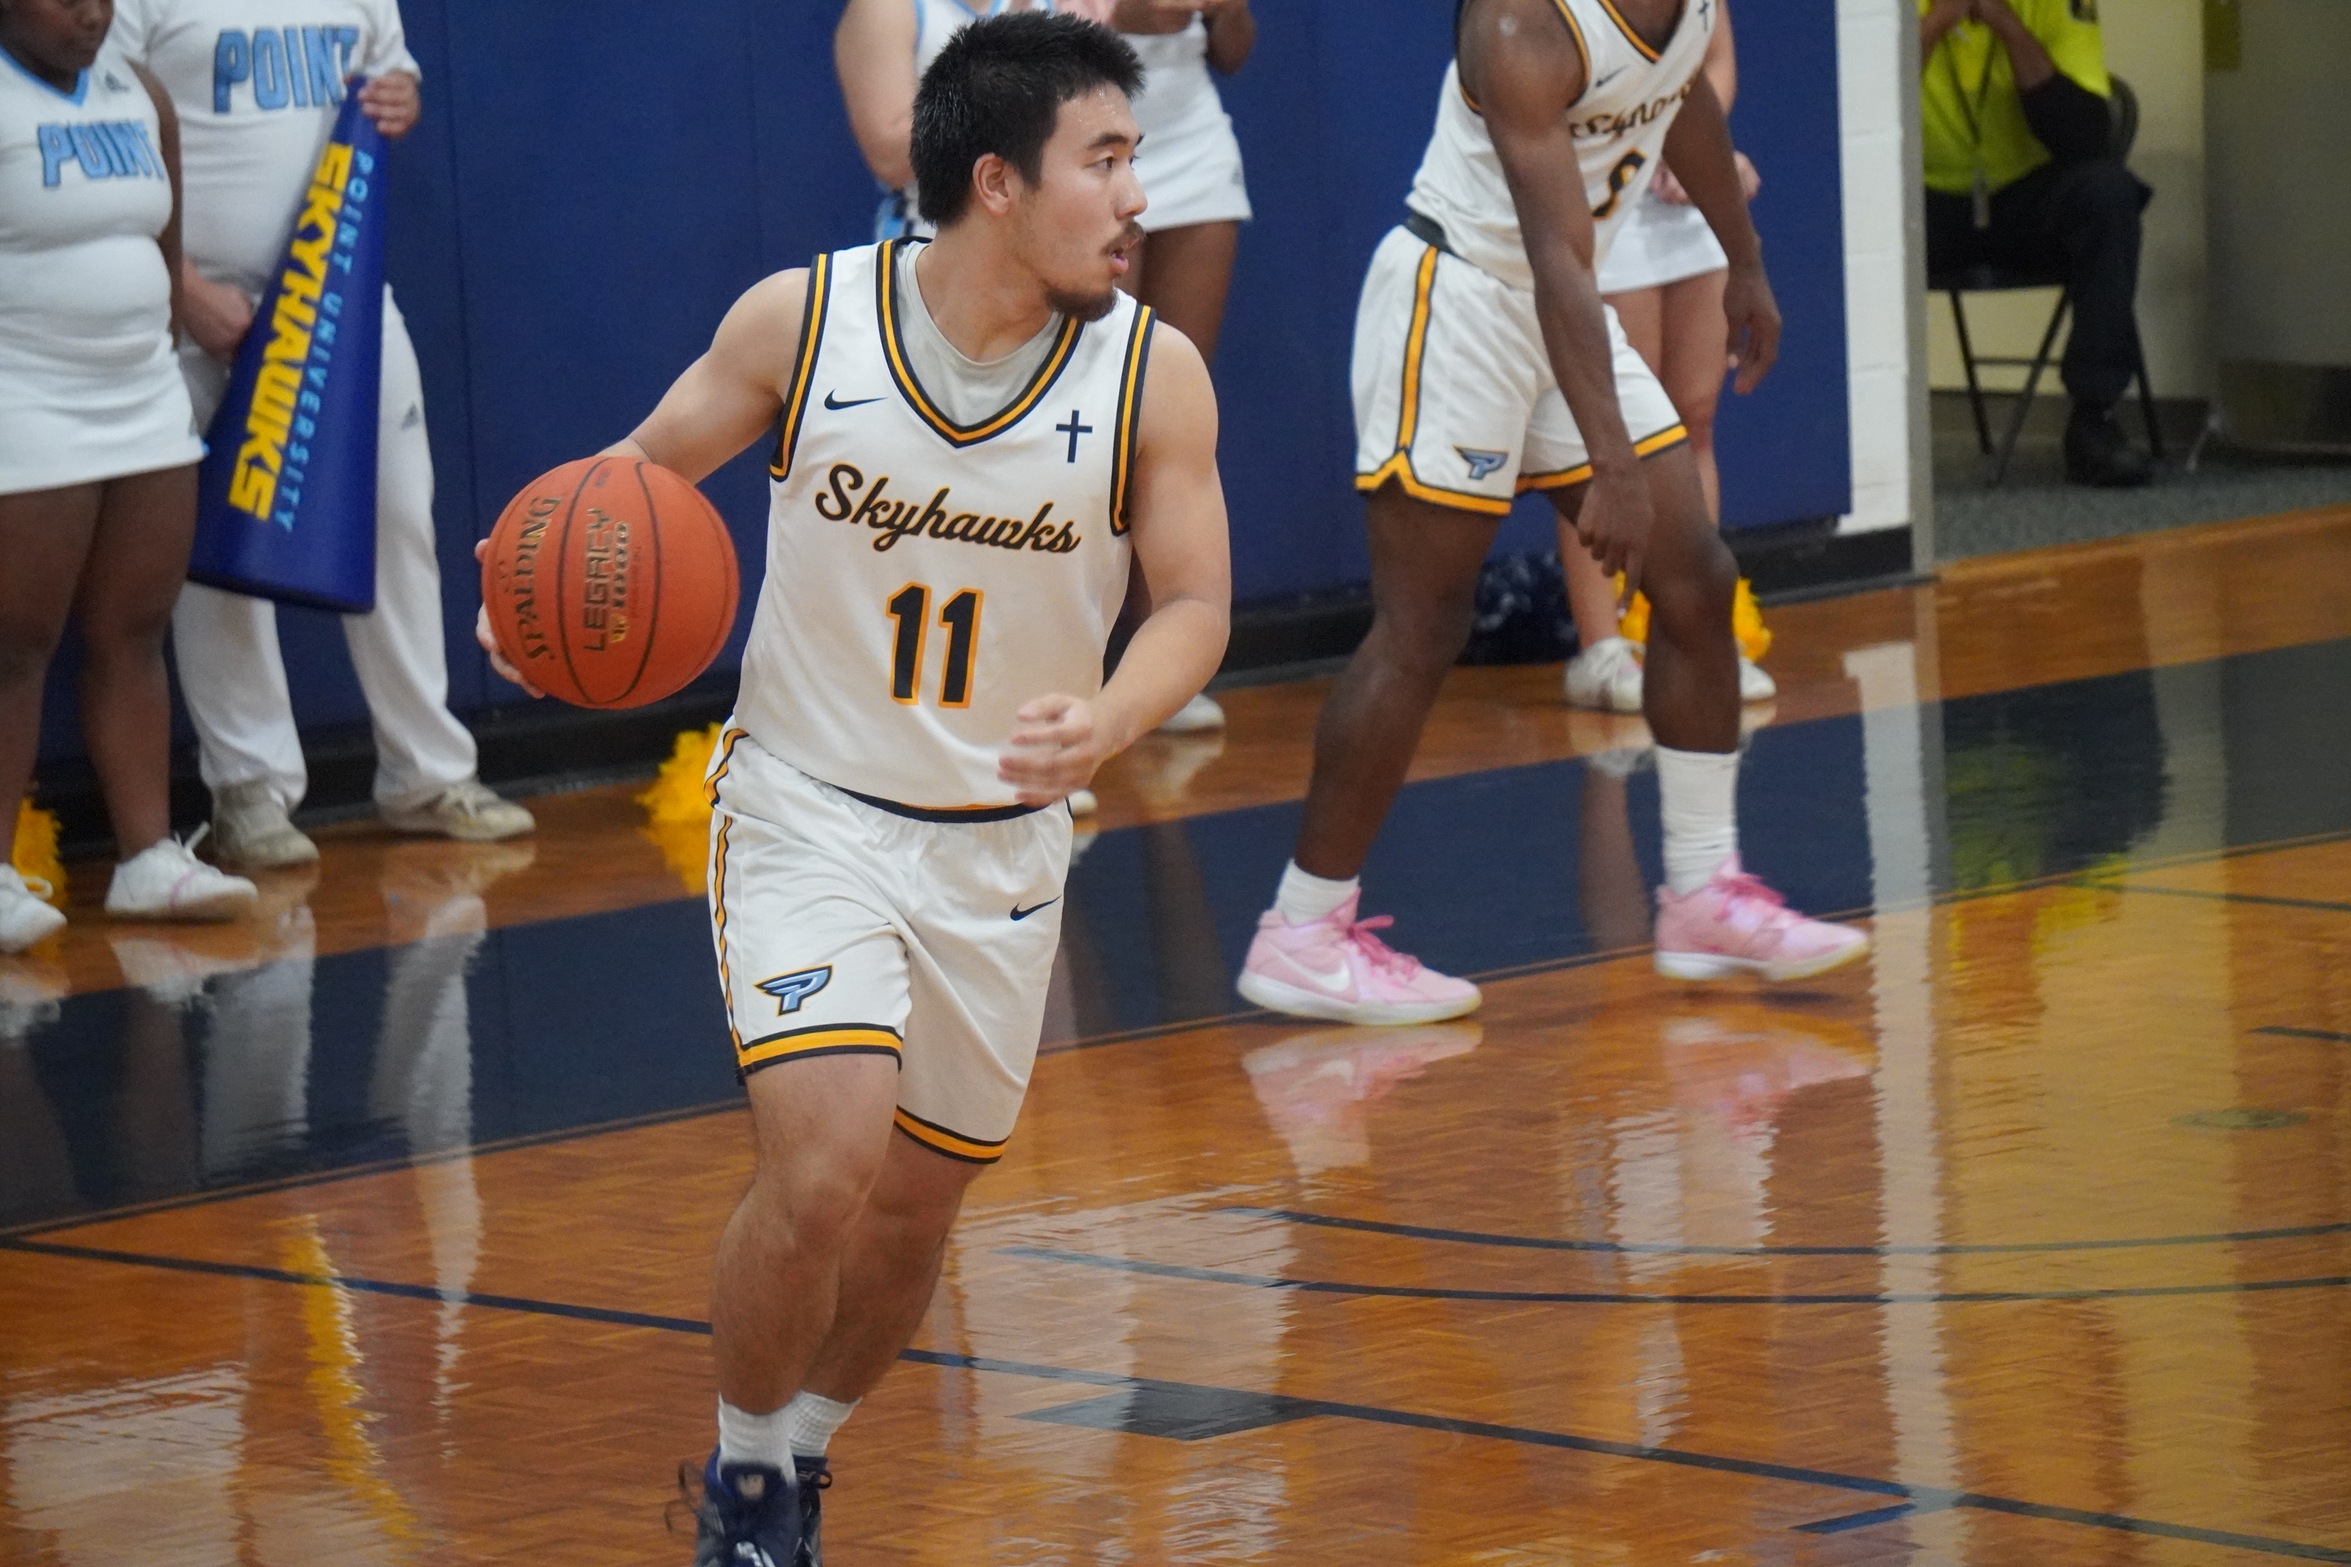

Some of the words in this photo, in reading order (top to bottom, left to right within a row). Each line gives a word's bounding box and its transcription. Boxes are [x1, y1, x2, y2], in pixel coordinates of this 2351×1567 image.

[212, 25, 359, 114] POINT
[333, 149, 375, 275] POINT
[227, 140, 354, 521] SKYHAWKS
[275, 291, 343, 534] UNIVERSITY
[814, 461, 1082, 555] Skyhawks
[513, 496, 561, 661] SPALDING
[584, 508, 614, 652] LEGACY
[885, 581, 984, 709] 11
